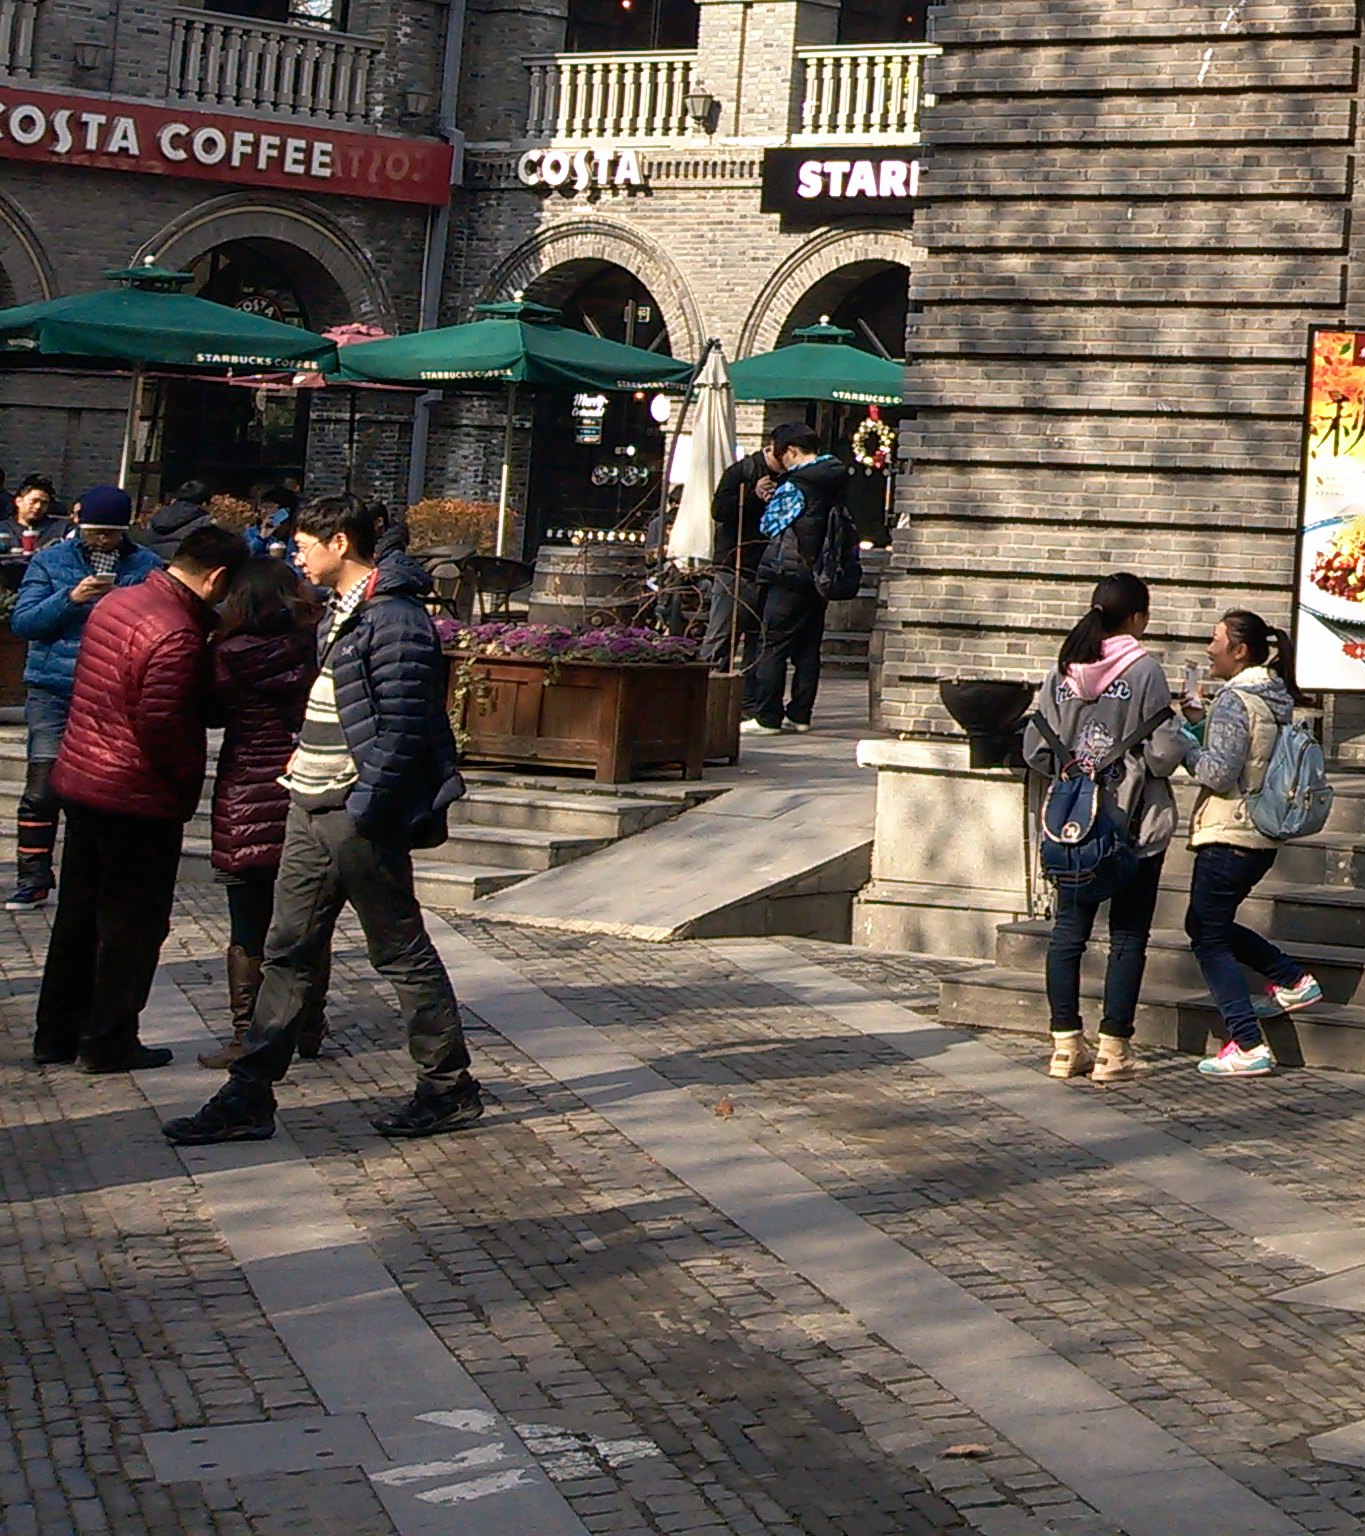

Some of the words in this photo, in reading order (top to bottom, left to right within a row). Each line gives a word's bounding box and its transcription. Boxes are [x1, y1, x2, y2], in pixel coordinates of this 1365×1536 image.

[0, 102, 140, 156] OSTA
[156, 122, 333, 177] COFFEE
[518, 149, 642, 191] COSTA
[237, 299, 275, 318] OSTA
[196, 353, 272, 366] STARBUCKS
[274, 357, 319, 370] COFFEE
